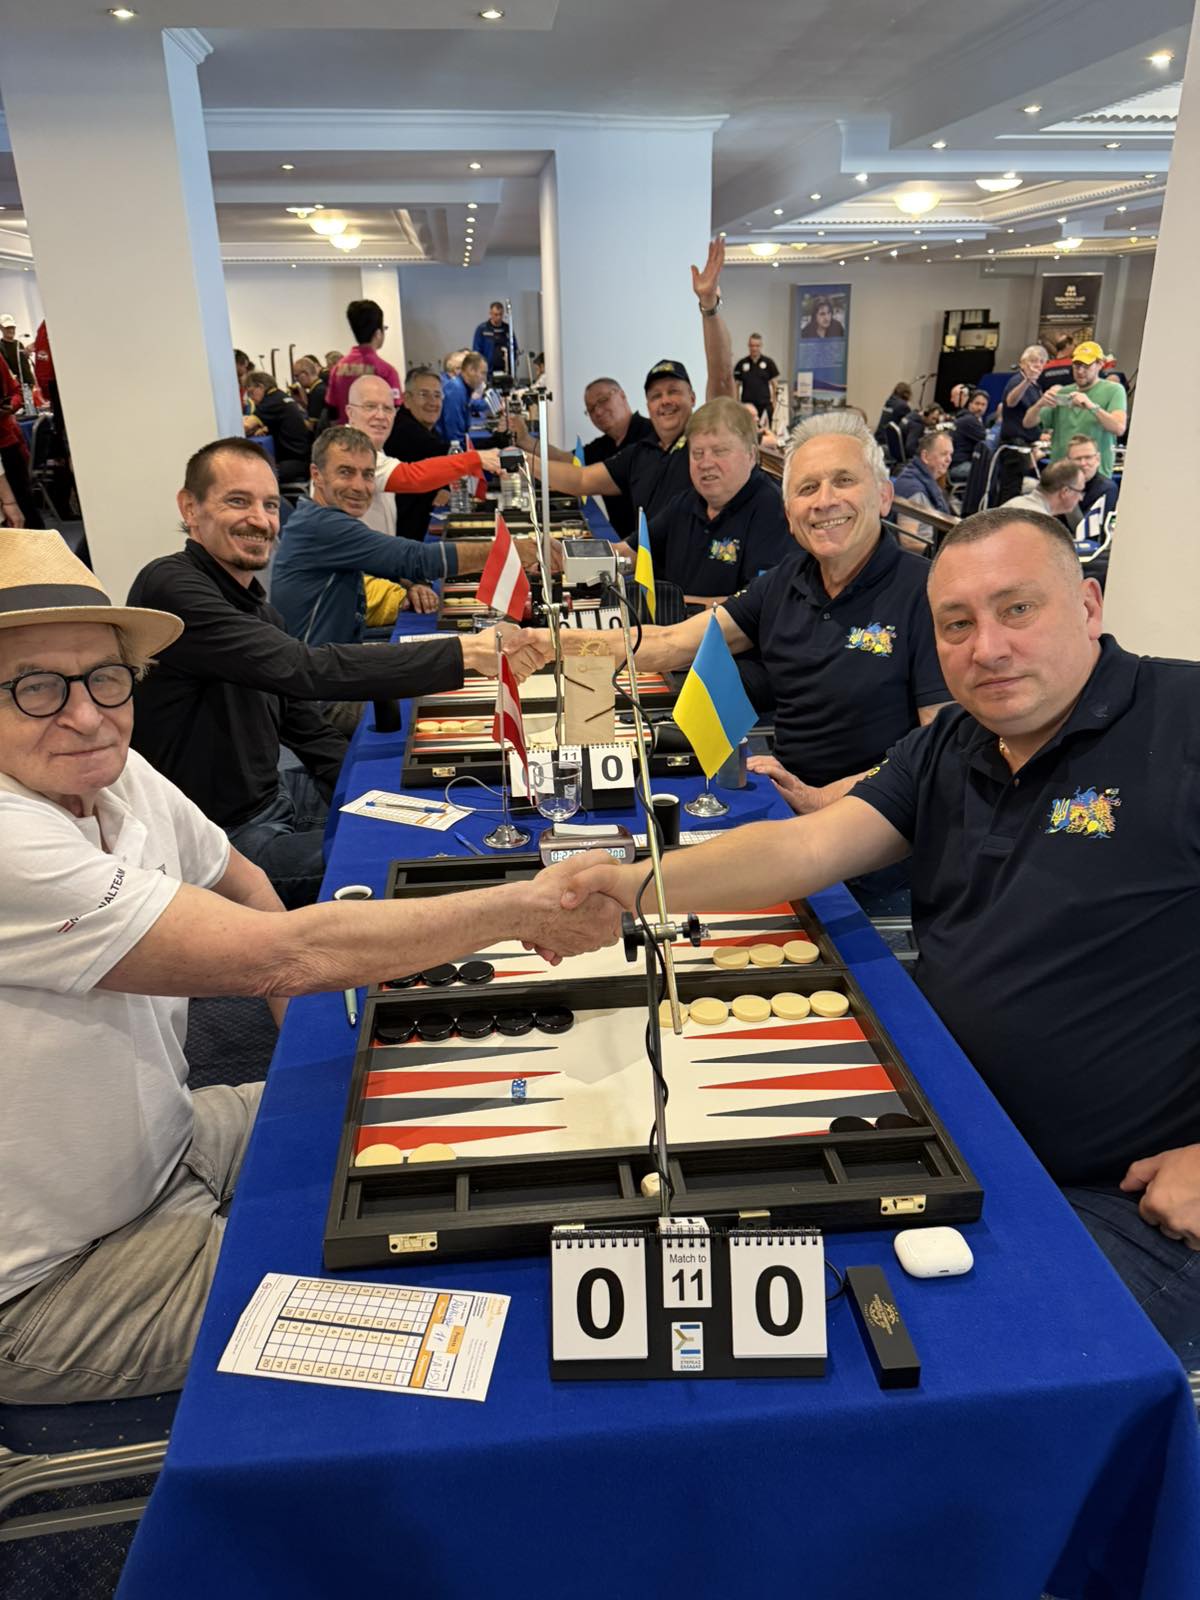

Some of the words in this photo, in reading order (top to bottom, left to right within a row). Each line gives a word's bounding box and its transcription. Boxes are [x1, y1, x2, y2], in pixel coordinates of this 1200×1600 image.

[562, 752, 577, 760] 11
[602, 755, 623, 781] 0
[669, 1253, 696, 1264] Match
[698, 1253, 707, 1264] to
[672, 1268, 703, 1301] 11
[576, 1267, 625, 1340] 0
[755, 1264, 803, 1337] 0
[450, 1331, 461, 1348] Points
